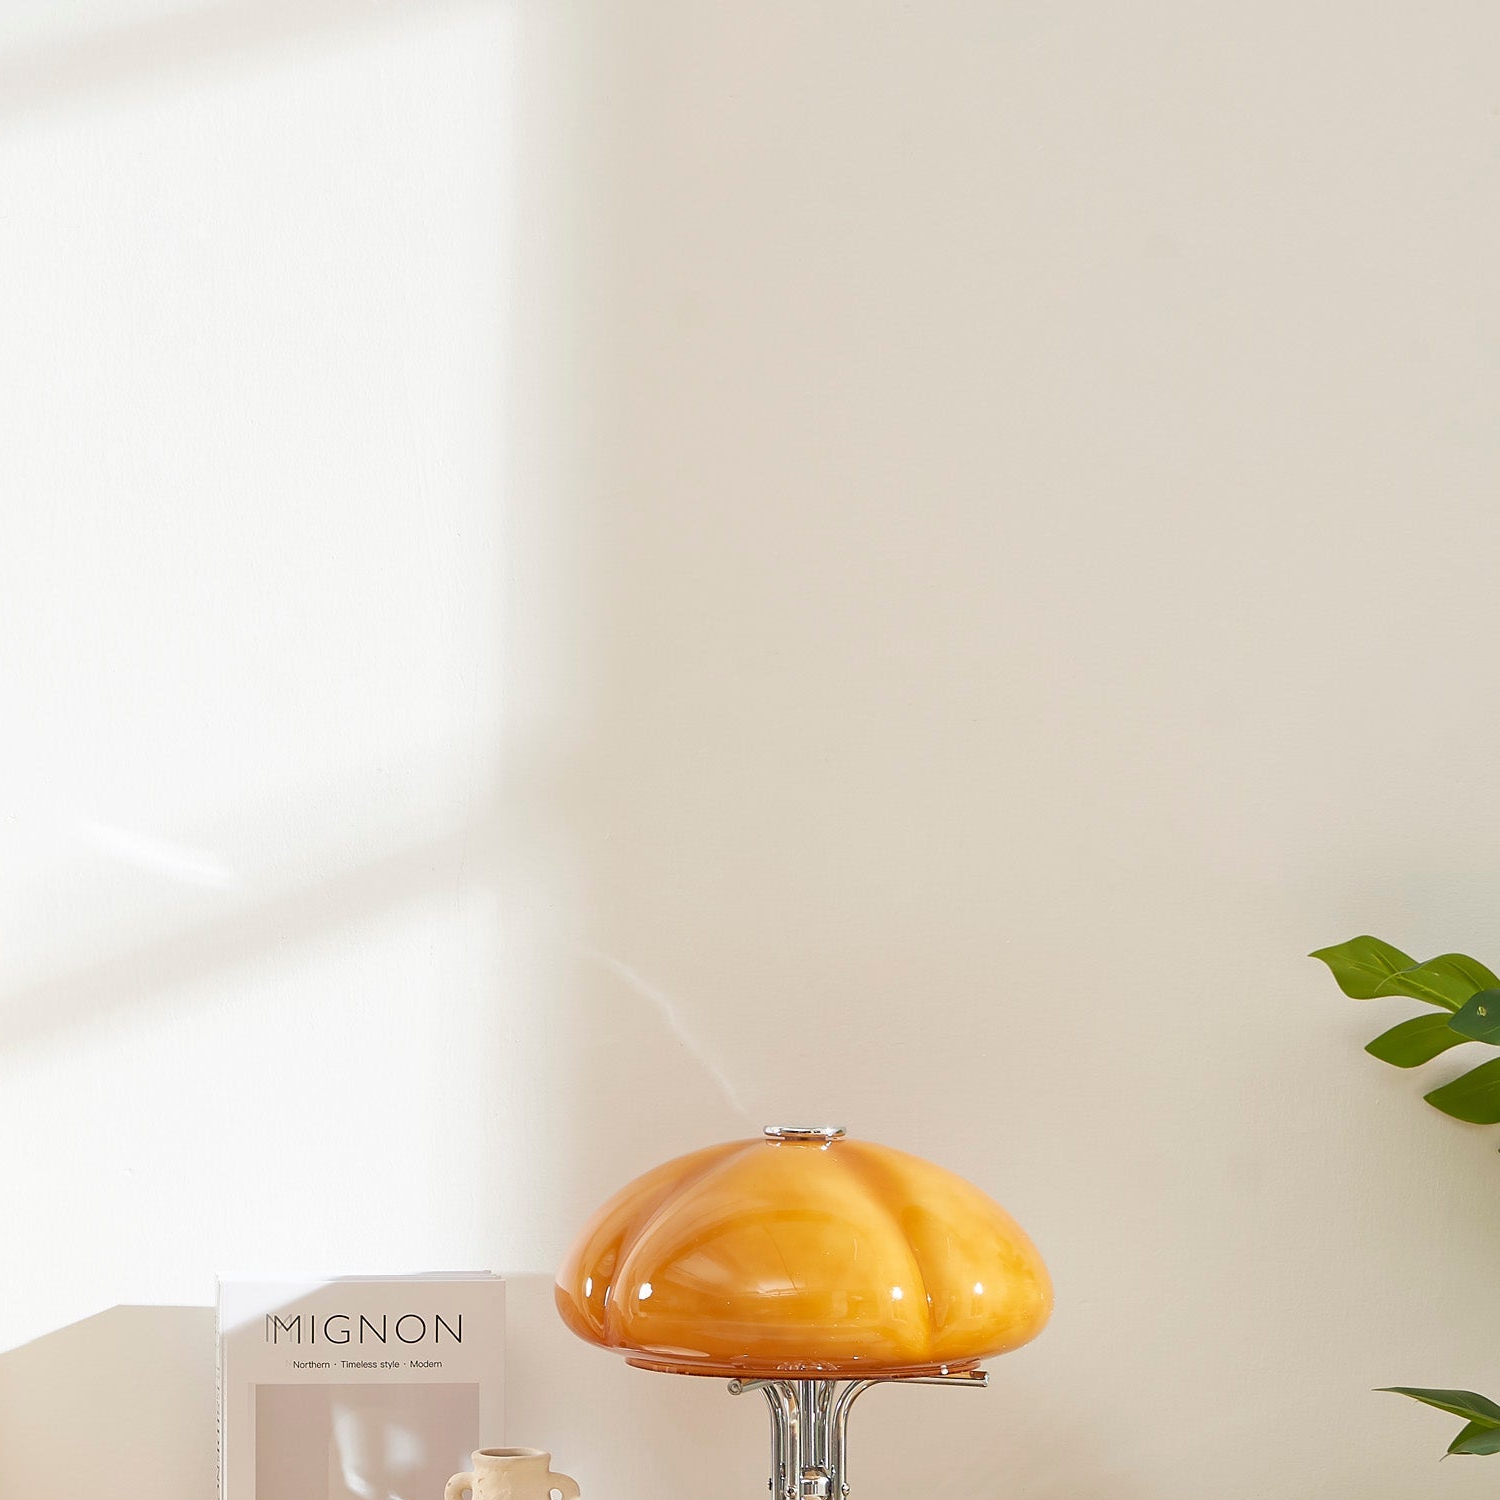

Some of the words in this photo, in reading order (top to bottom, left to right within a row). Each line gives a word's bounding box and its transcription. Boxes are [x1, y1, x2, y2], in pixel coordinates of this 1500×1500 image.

[274, 1314, 463, 1344] MIGNON
[293, 1360, 331, 1369] Northern
[340, 1360, 378, 1369] Timeless
[380, 1360, 400, 1371] style
[409, 1360, 442, 1368] Modern
